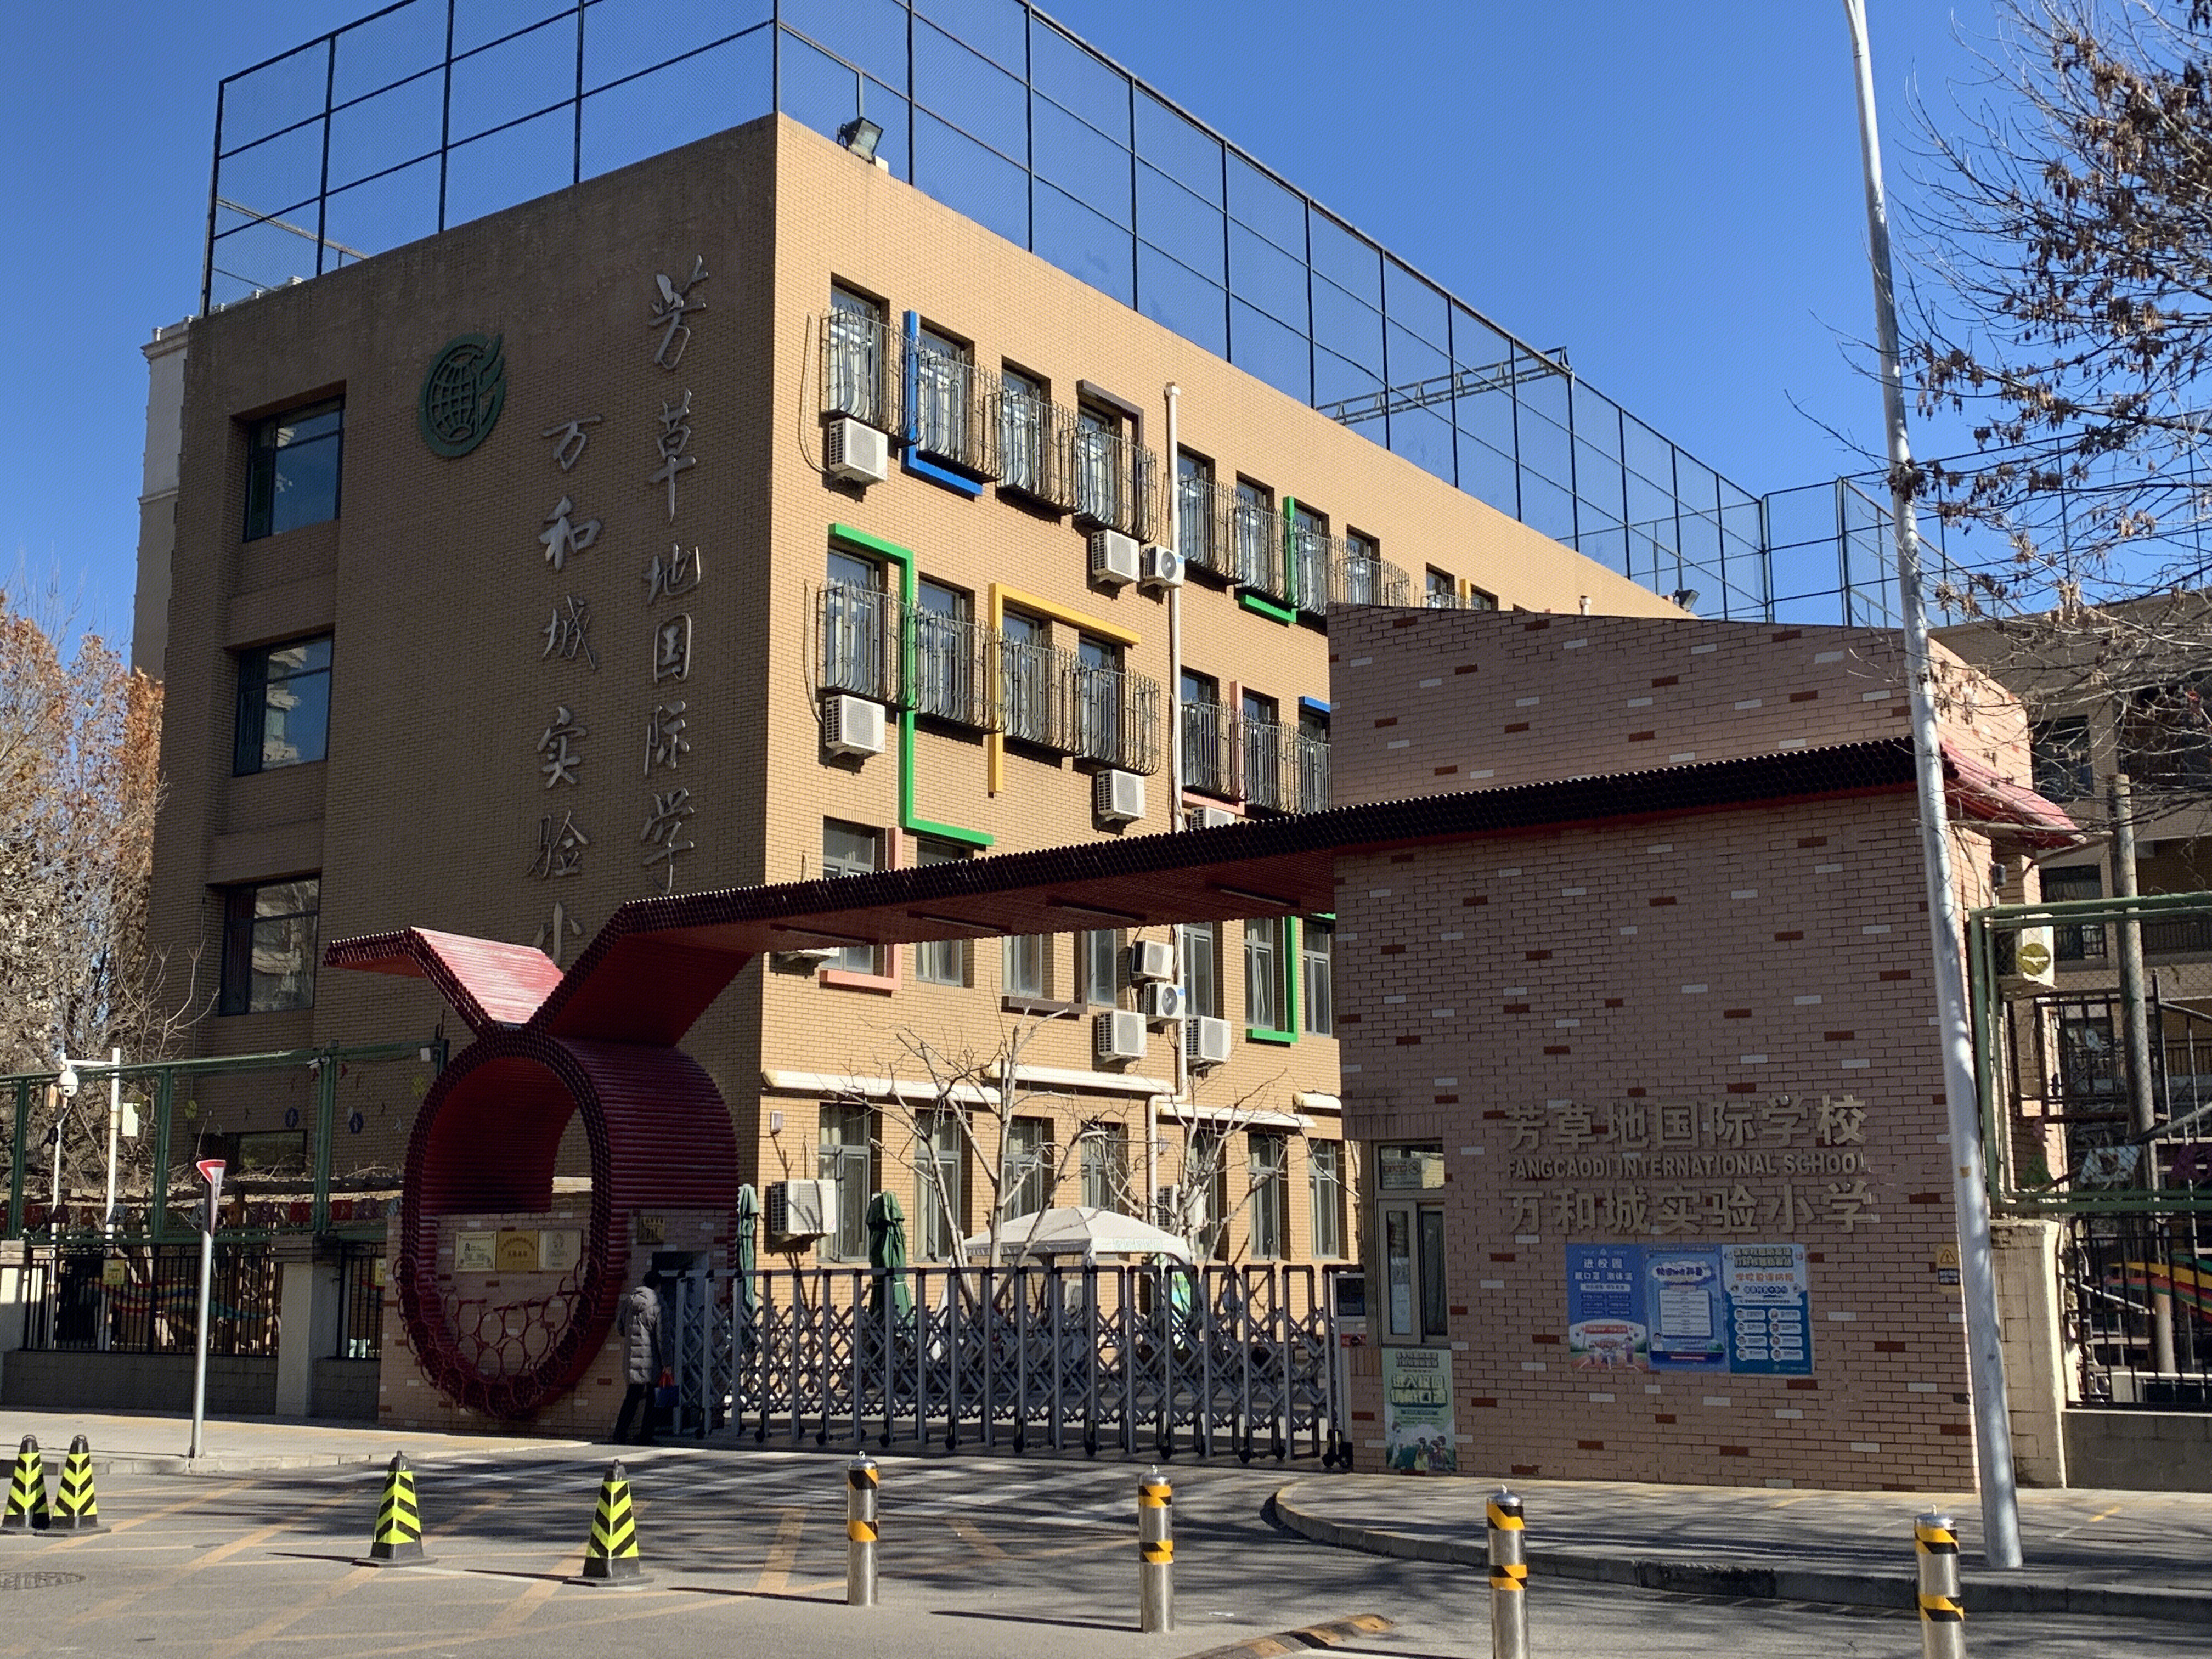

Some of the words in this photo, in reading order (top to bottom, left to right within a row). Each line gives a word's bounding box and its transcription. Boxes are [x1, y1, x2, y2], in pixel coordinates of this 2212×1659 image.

[1505, 1094, 1868, 1150] 芳草地国际学校
[1508, 1157, 1611, 1178] FANGCAODI
[1617, 1154, 1778, 1177] INTERNATIONAL
[1783, 1152, 1870, 1174] SCHOOL
[1504, 1180, 1881, 1235] 万和城实验小学
